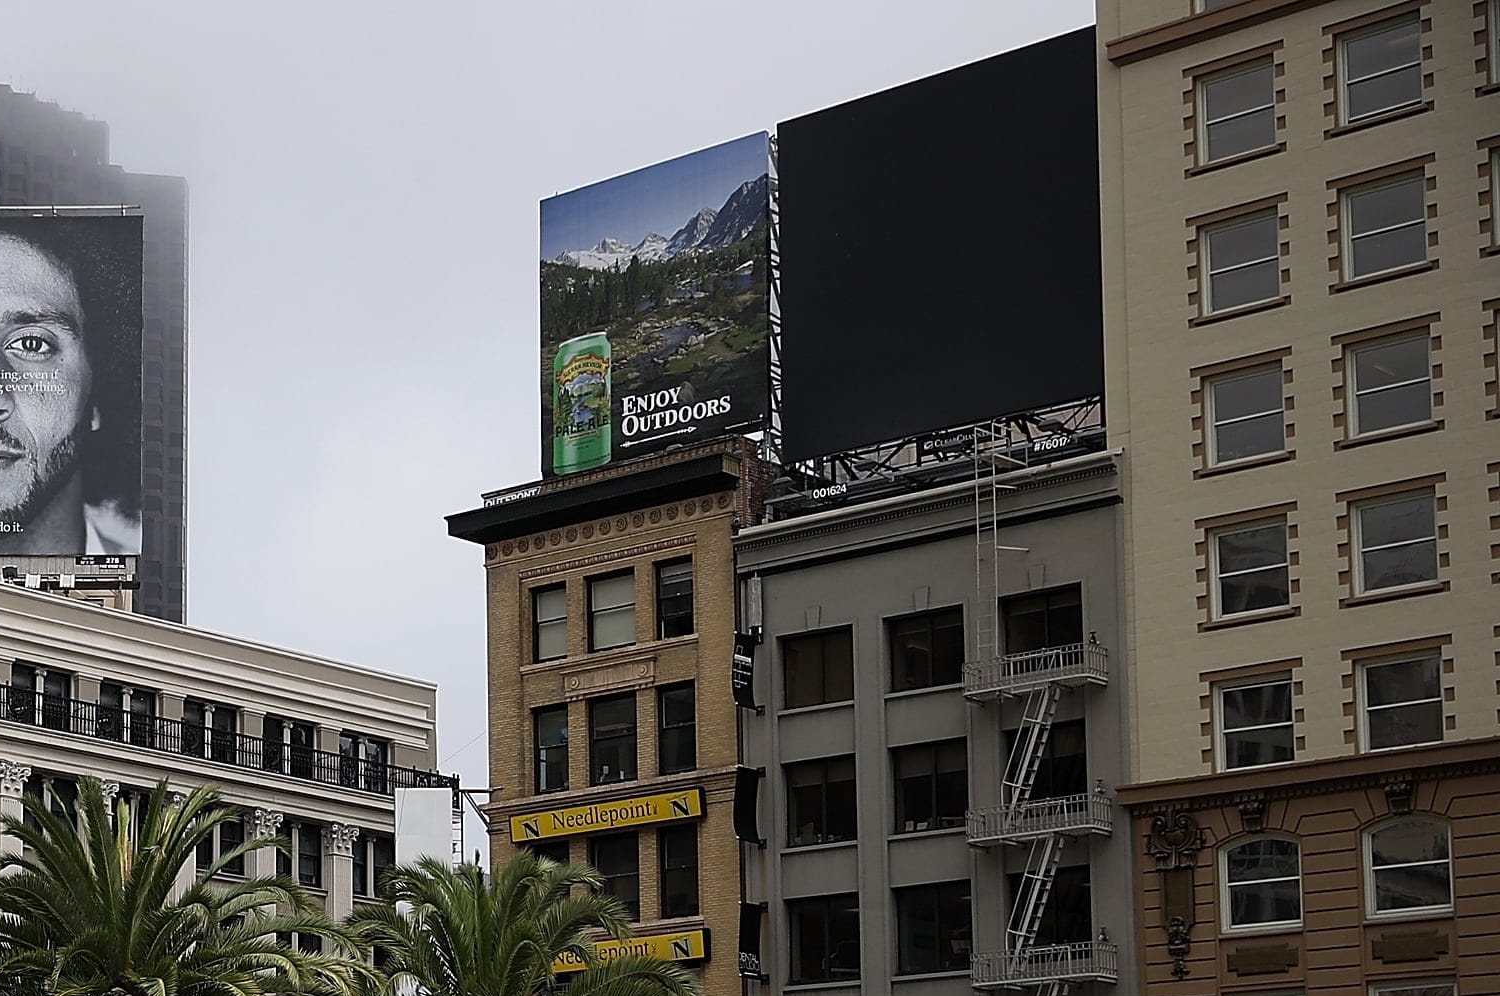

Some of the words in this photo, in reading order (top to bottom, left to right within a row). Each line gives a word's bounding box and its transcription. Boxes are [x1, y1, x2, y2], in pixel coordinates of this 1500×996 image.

[22, 371, 49, 380] even
[51, 369, 60, 380] if
[5, 382, 67, 394] everything.
[621, 386, 682, 417] ENJOY
[621, 395, 731, 436] OUTDOORS
[555, 421, 585, 437] PALE
[588, 415, 610, 430] ALE
[812, 483, 847, 499] 001624
[12, 522, 24, 533] it.
[551, 800, 652, 831] Needlepoint
[670, 797, 691, 817] N
[522, 819, 541, 839] N
[671, 938, 690, 959] N
